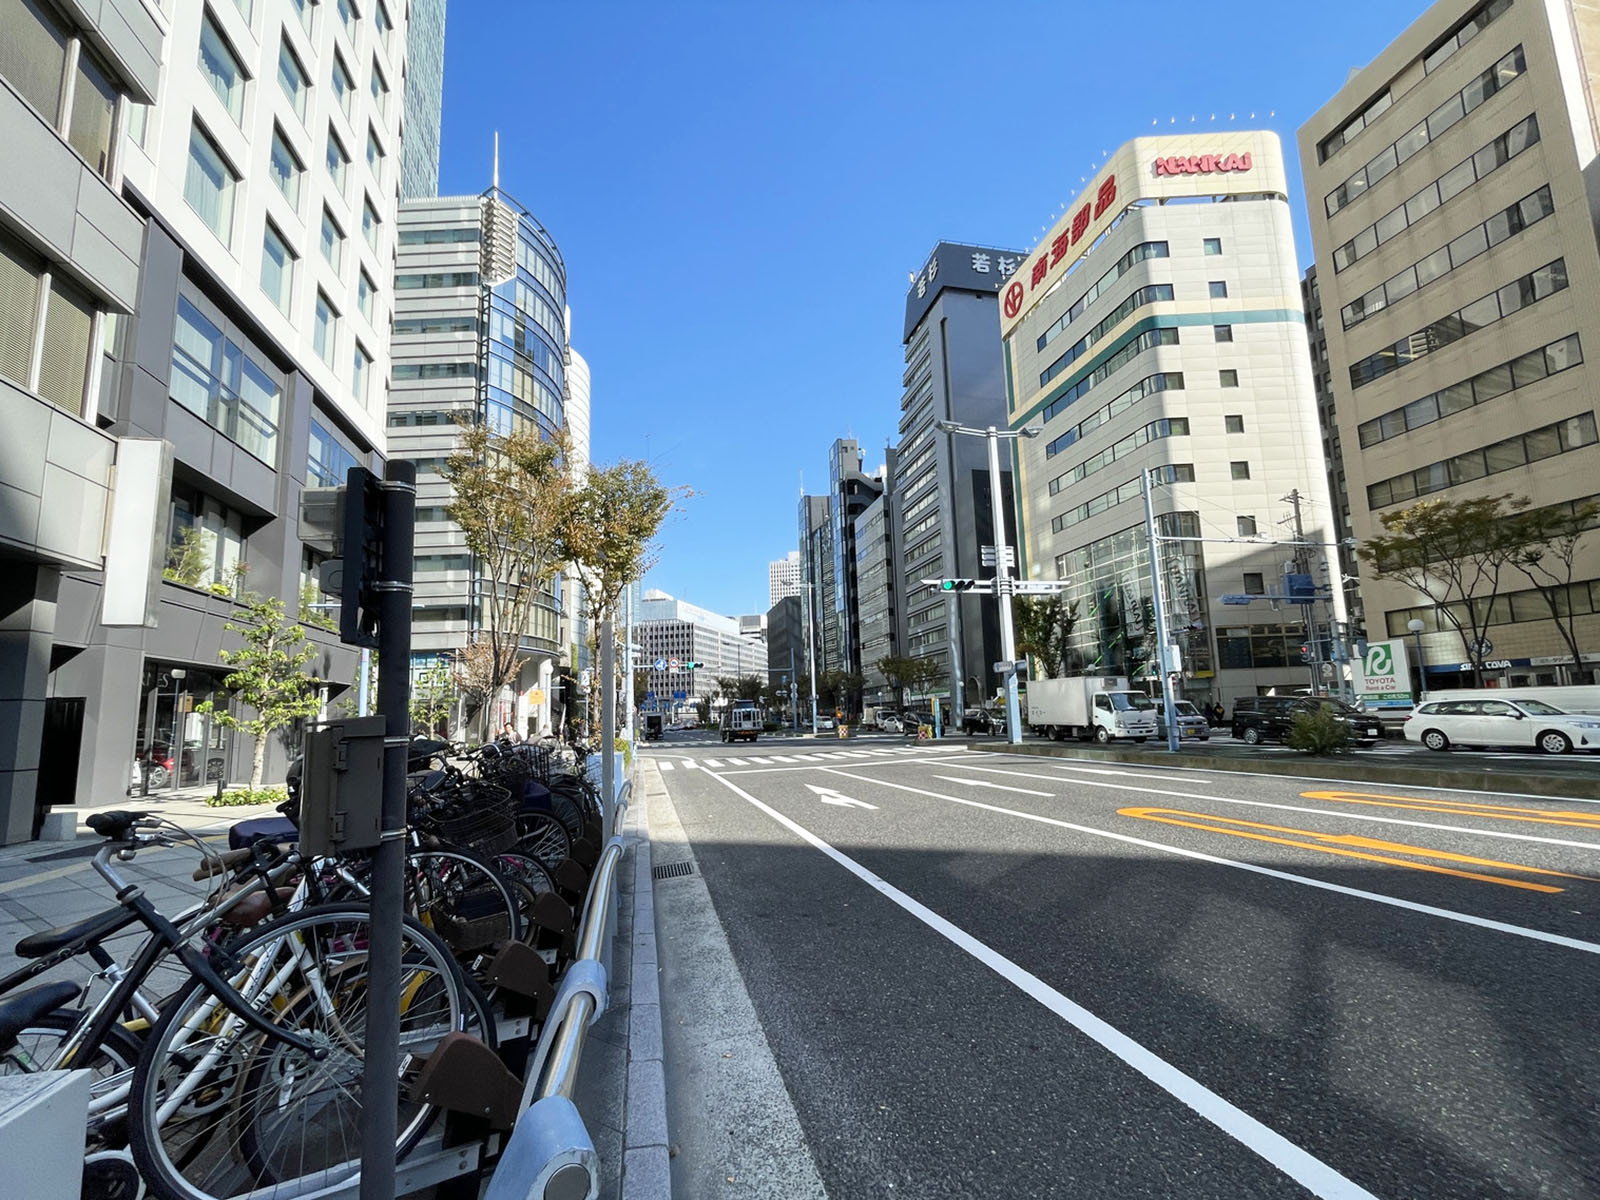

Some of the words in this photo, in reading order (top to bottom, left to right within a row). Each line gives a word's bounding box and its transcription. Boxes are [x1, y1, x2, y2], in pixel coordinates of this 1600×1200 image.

[1156, 152, 1252, 176] NANKAI
[1031, 174, 1117, 292] 南海部品
[1365, 677, 1396, 685] TOYOTA
